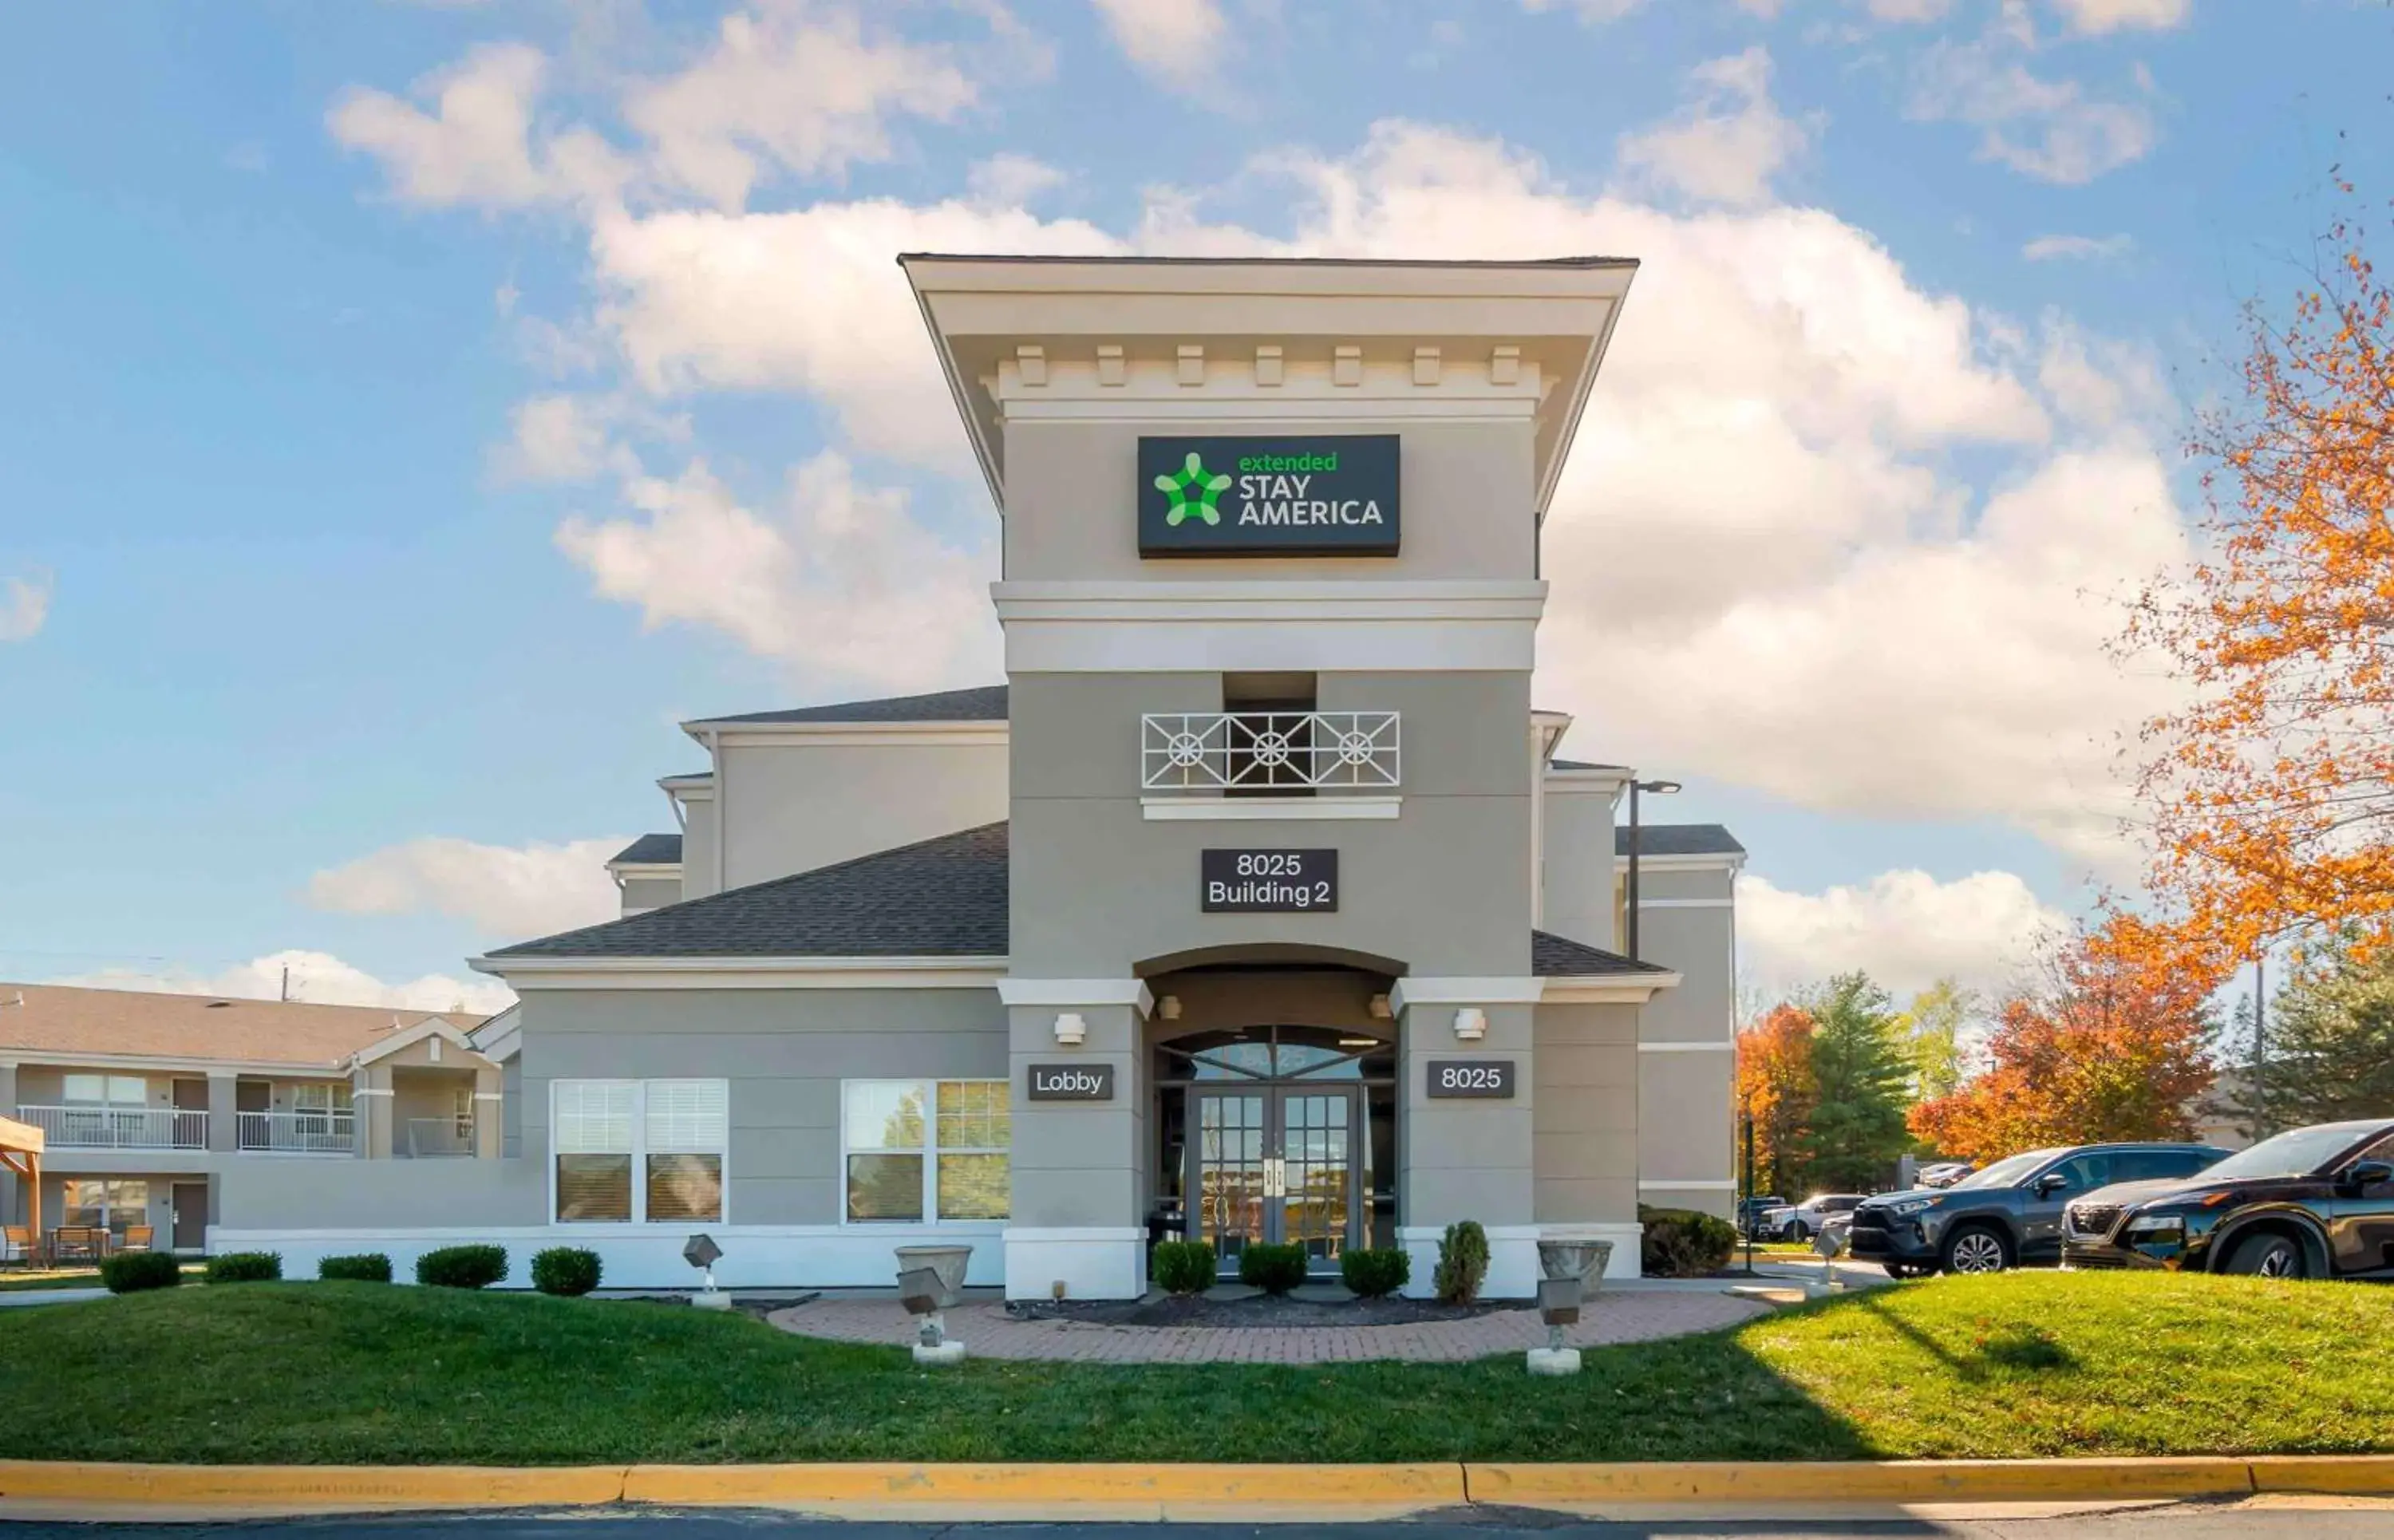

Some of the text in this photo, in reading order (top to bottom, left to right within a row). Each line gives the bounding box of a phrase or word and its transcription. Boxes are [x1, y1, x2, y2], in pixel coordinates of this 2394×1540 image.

[1238, 452, 1337, 472] extended
[1238, 475, 1311, 500] STAY
[1238, 500, 1383, 526] AMERICA
[1237, 854, 1302, 876] 8025
[1209, 881, 1330, 907] Building 2
[1037, 1072, 1103, 1094] Lobby
[1442, 1068, 1501, 1088] 8025
